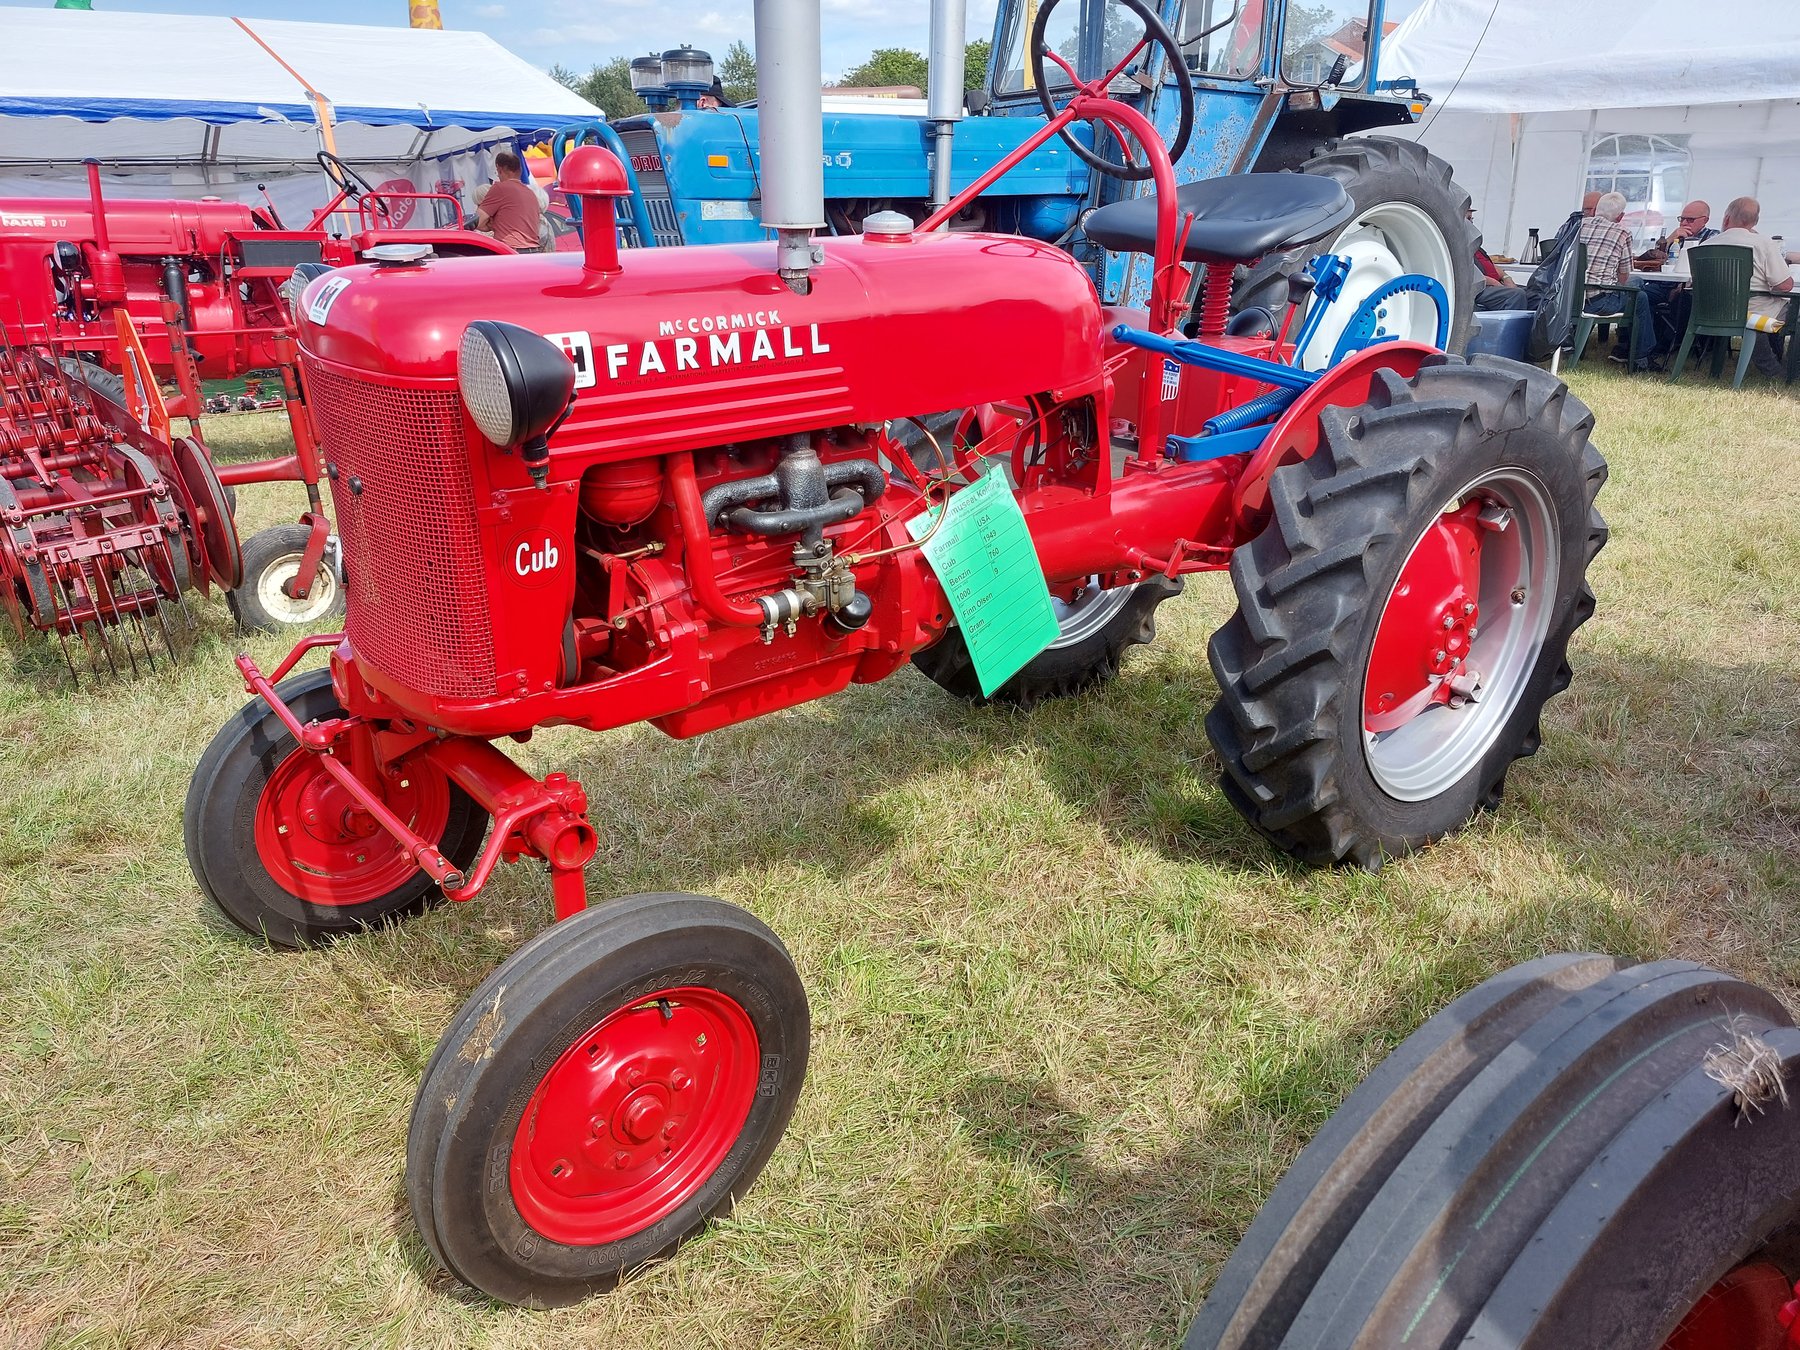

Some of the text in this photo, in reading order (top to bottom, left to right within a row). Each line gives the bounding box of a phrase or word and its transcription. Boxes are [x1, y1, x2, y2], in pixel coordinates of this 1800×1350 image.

[630, 154, 664, 171] ORD
[606, 323, 831, 379] FARMALL
[976, 514, 991, 527] USA
[933, 535, 960, 554] Farmall
[983, 529, 997, 543] 1949
[515, 538, 559, 576] Cub
[941, 558, 957, 570] Cub
[948, 568, 972, 586] Benzin
[956, 588, 971, 602] 1000
[962, 592, 994, 618] Finn Olsen
[968, 619, 985, 633] Gram
